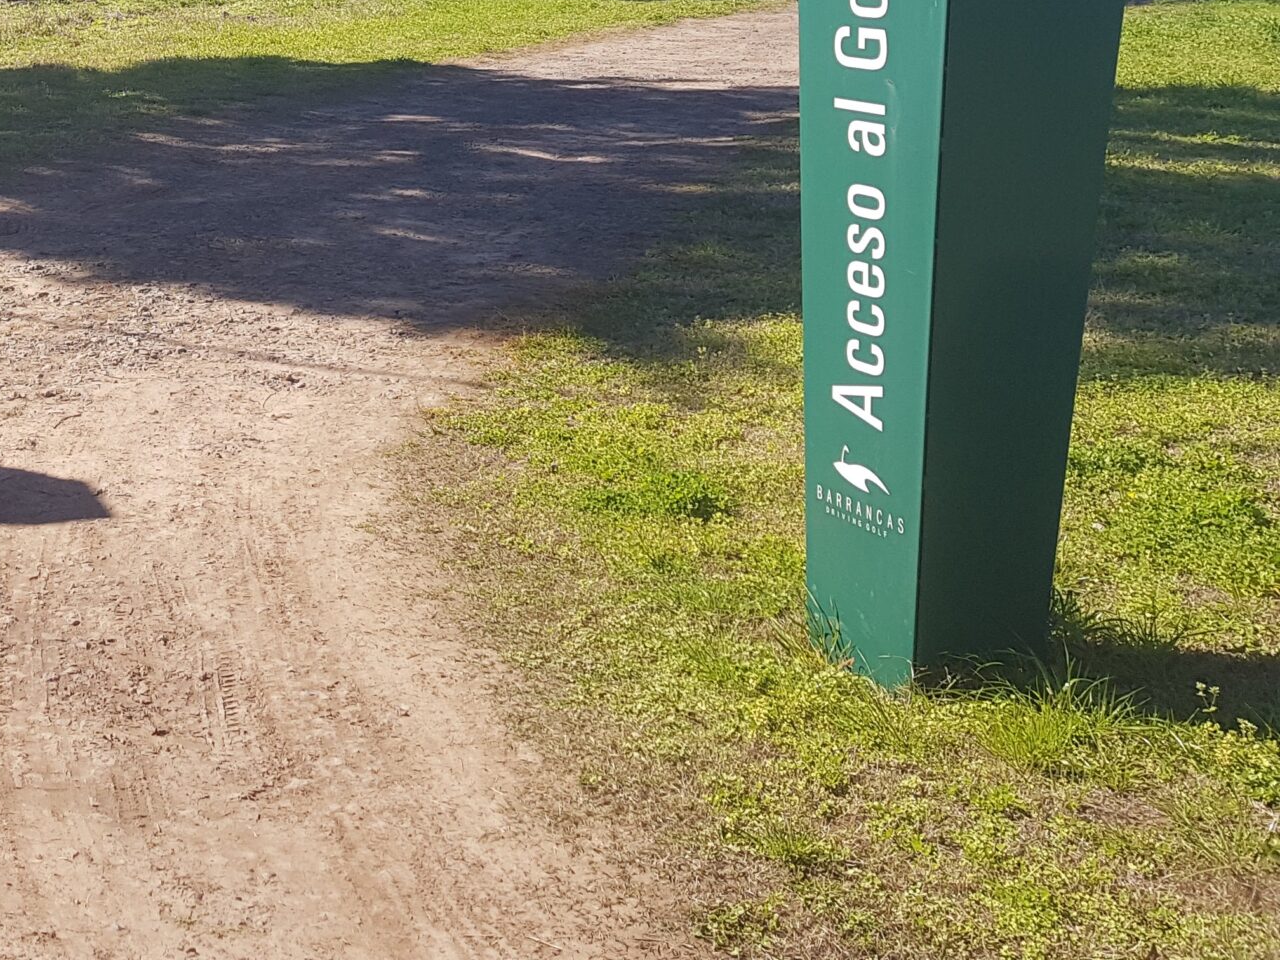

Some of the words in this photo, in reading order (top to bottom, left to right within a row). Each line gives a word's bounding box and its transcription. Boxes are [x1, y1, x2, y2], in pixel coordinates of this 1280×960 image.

[834, 97, 886, 157] al
[831, 183, 886, 432] Acceso
[816, 484, 905, 534] BARRANCAS
[825, 506, 862, 527] DRIVING
[865, 524, 888, 538] GOLF
